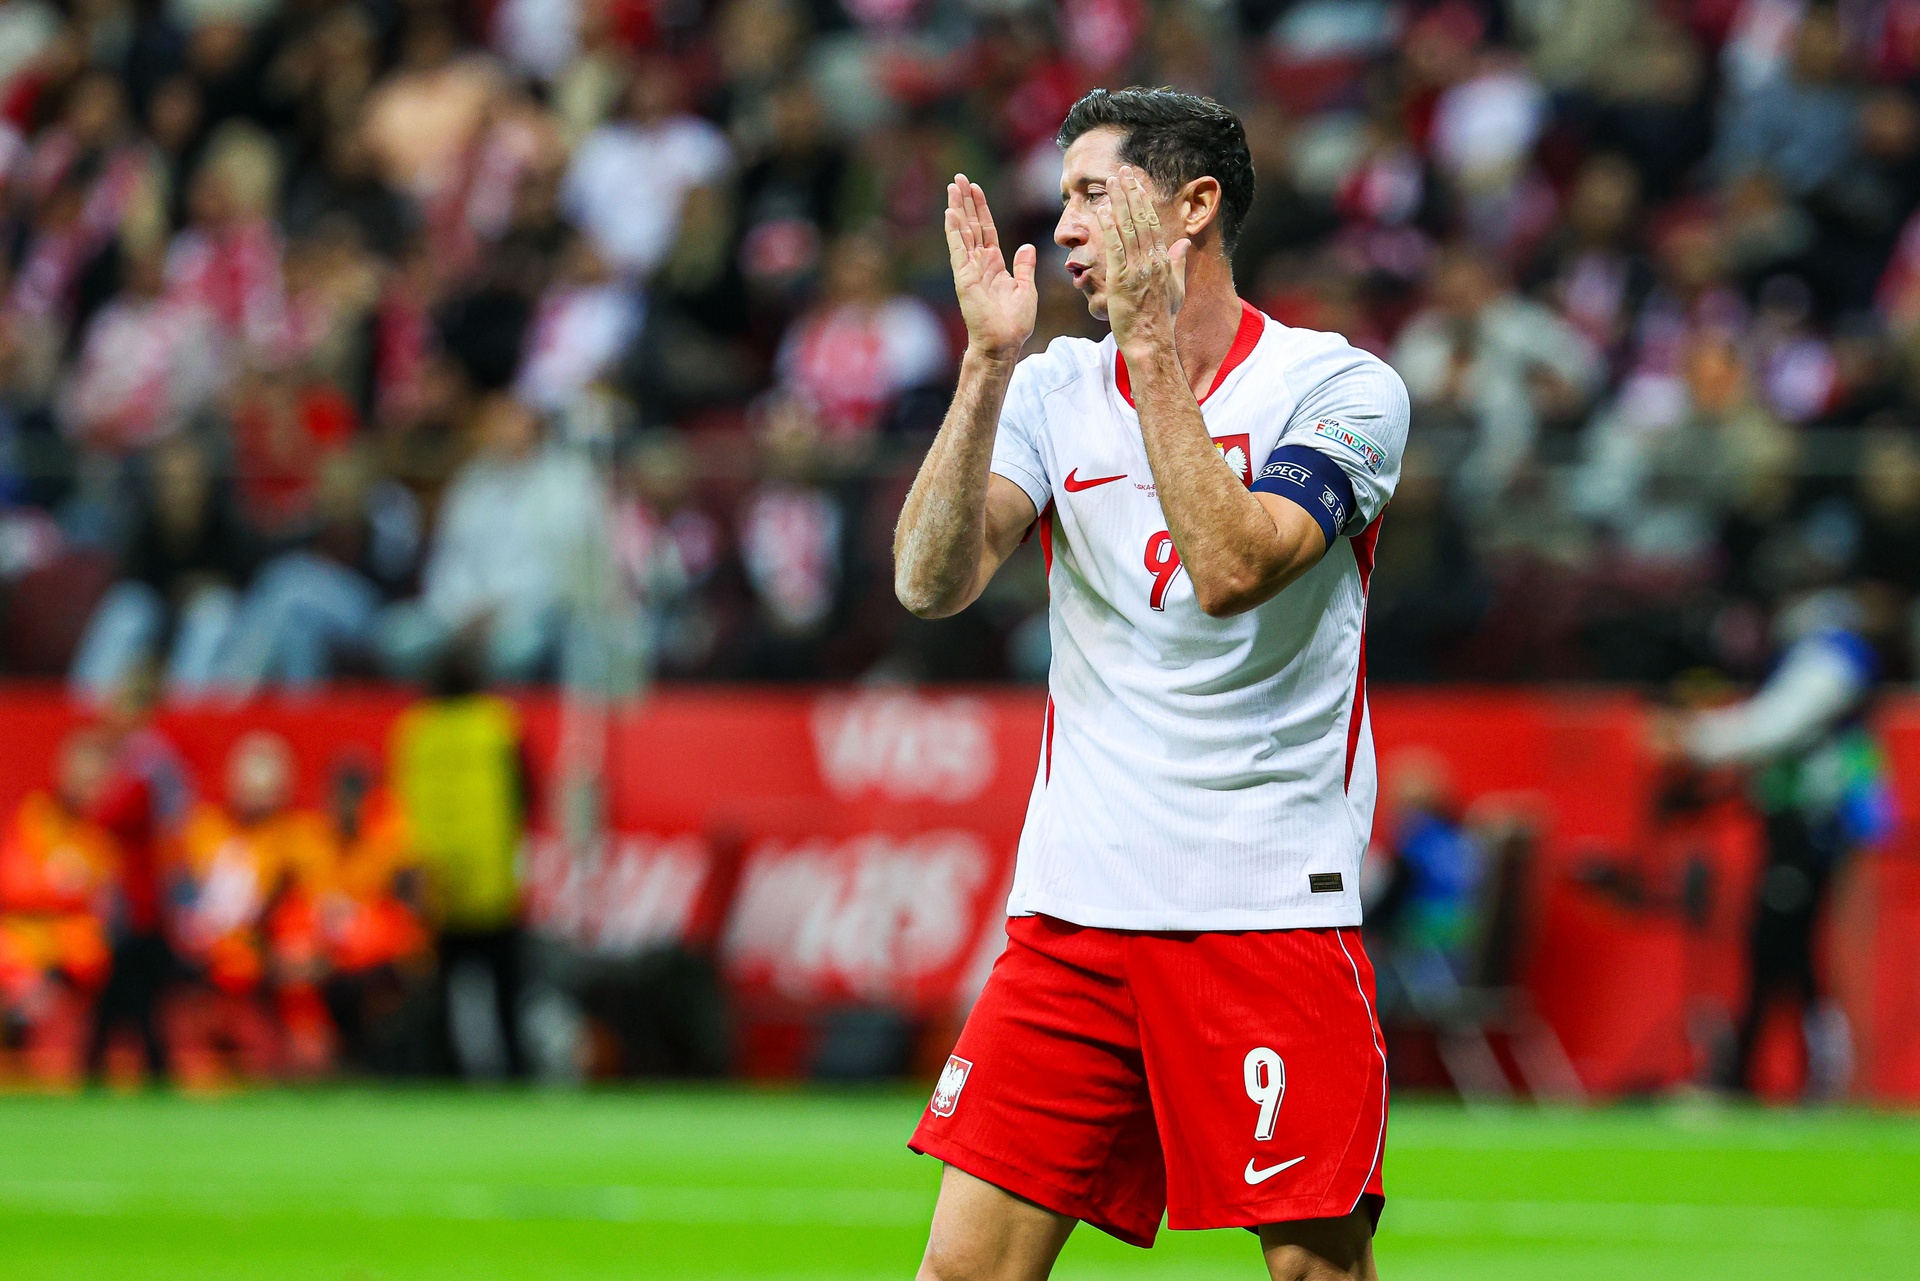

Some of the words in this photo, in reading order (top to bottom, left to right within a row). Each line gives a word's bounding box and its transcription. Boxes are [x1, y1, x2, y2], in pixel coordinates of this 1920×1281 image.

[1316, 423, 1384, 469] FOUNDATION
[1320, 418, 1339, 428] UEFA
[1258, 465, 1311, 483] SPECT
[1144, 530, 1183, 612] 9
[1243, 1046, 1286, 1141] 9
